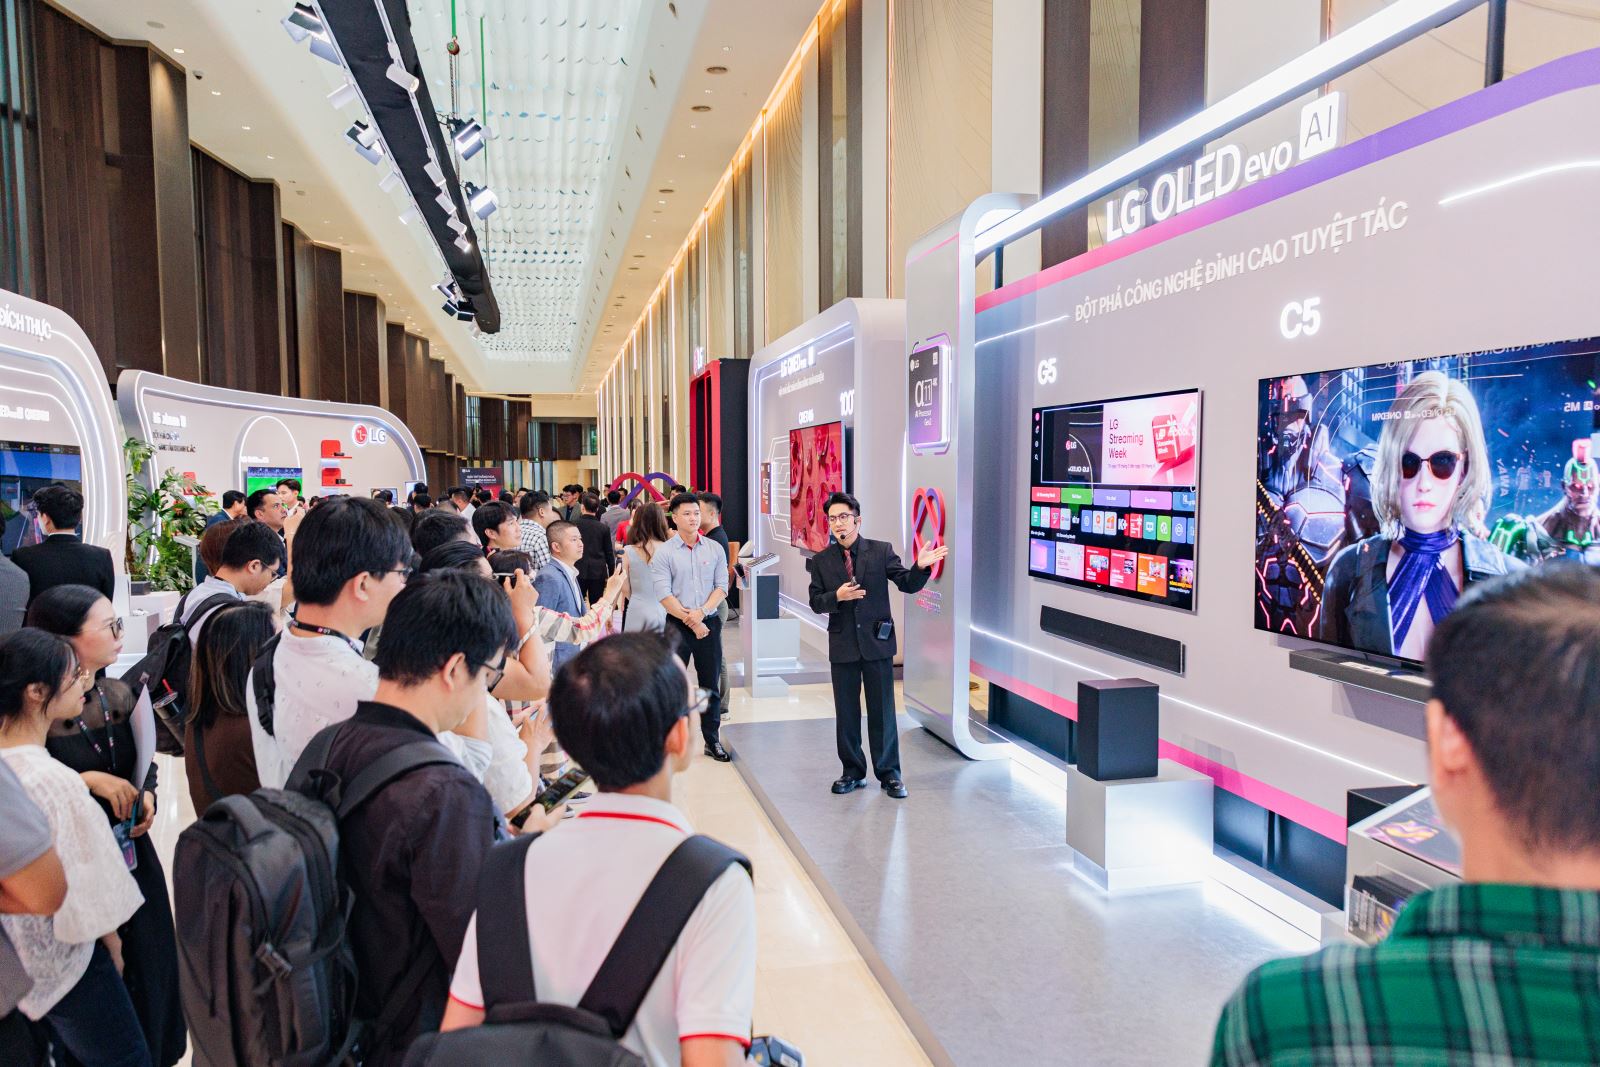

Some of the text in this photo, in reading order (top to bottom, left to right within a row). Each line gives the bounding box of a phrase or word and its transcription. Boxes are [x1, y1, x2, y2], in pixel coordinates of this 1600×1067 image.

[1106, 104, 1332, 242] LG OLED evo AI
[1075, 295, 1099, 323] ĐỘT
[1099, 285, 1123, 315] PHÁ
[1124, 278, 1163, 307] CÔNG
[1163, 258, 1204, 292] NGHỆ
[1247, 238, 1289, 272] CAO
[1290, 211, 1358, 259] TUYỆT
[1360, 195, 1409, 238] TÁC
[1280, 296, 1321, 339] C5
[1037, 357, 1057, 386] G5
[1109, 418, 1119, 430] LG
[370, 428, 387, 443] LG
[1109, 432, 1144, 446] Streaming
[1108, 447, 1127, 459] Week
